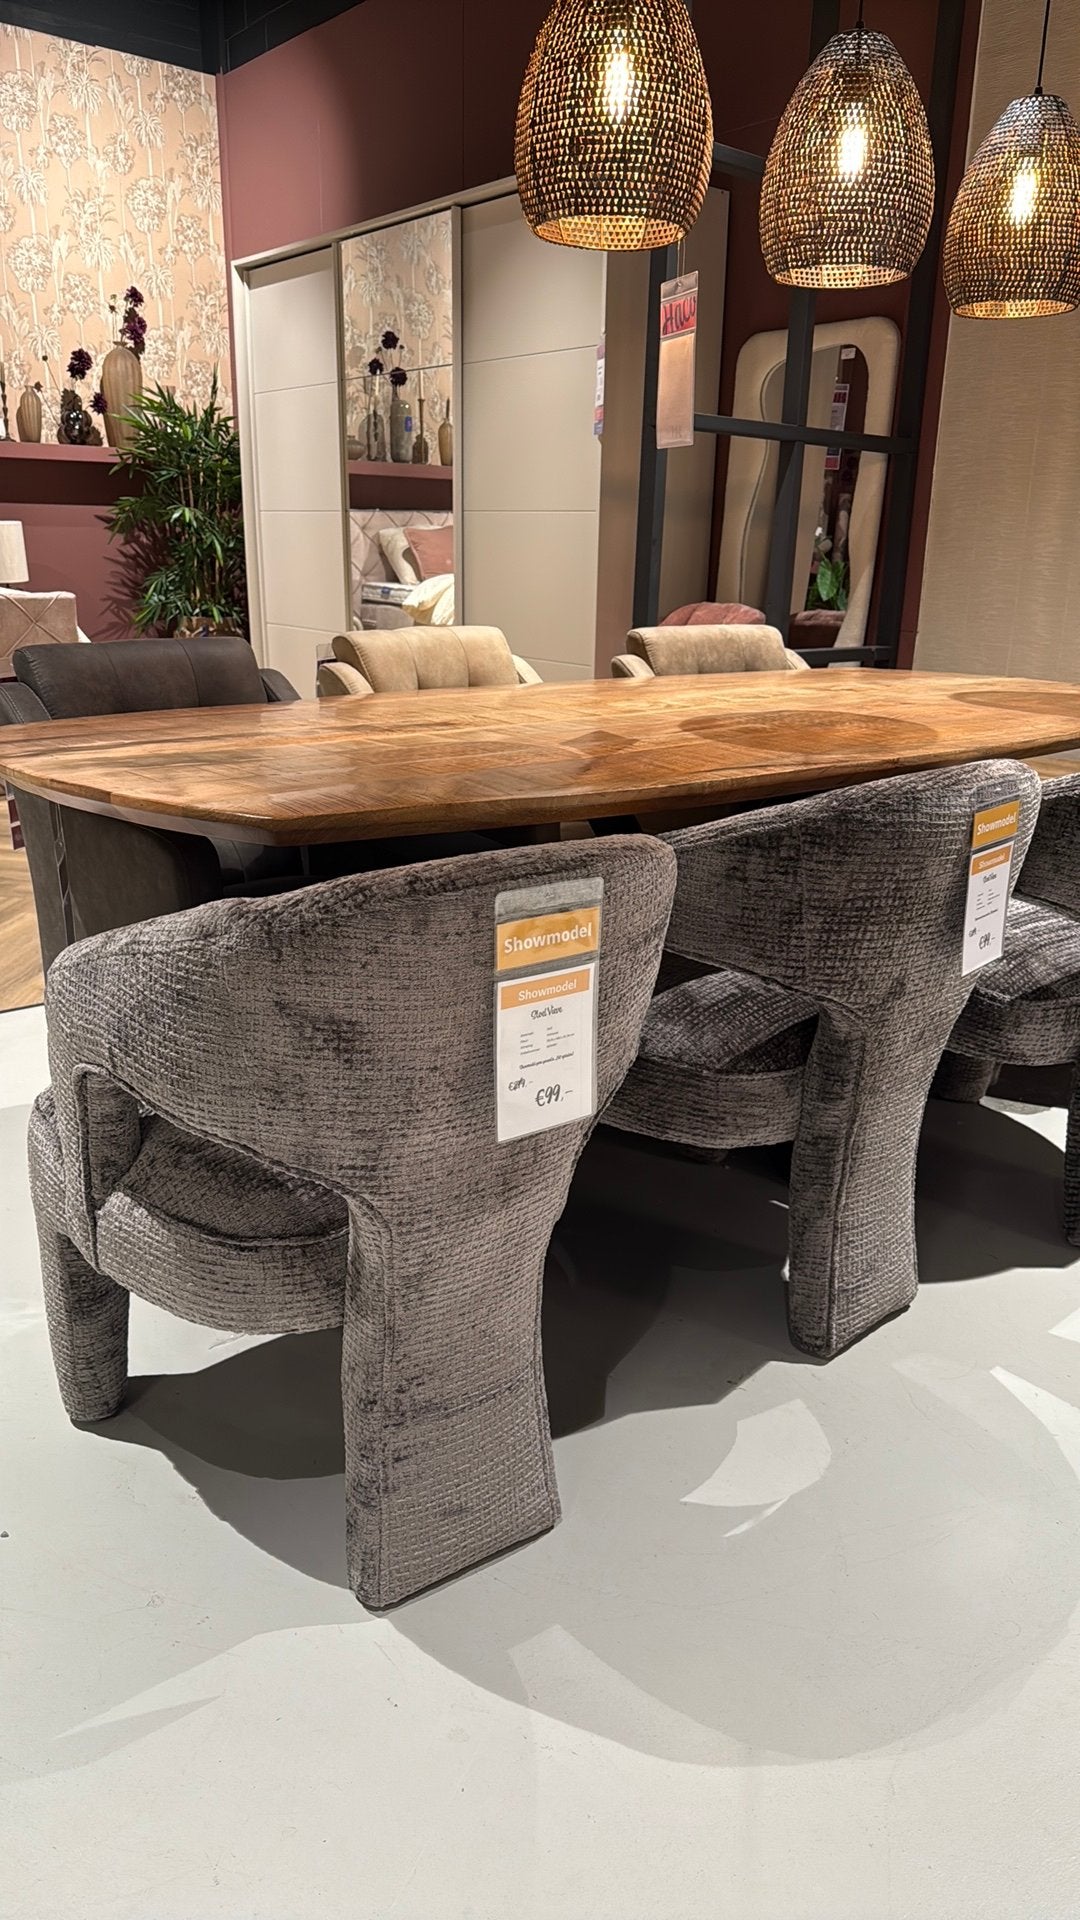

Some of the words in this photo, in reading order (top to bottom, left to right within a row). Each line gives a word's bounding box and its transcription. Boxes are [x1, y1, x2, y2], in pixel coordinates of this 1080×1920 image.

[977, 812, 1016, 835] Showmodel
[504, 922, 592, 953] Showmodel
[518, 979, 577, 1001] Showmodel
